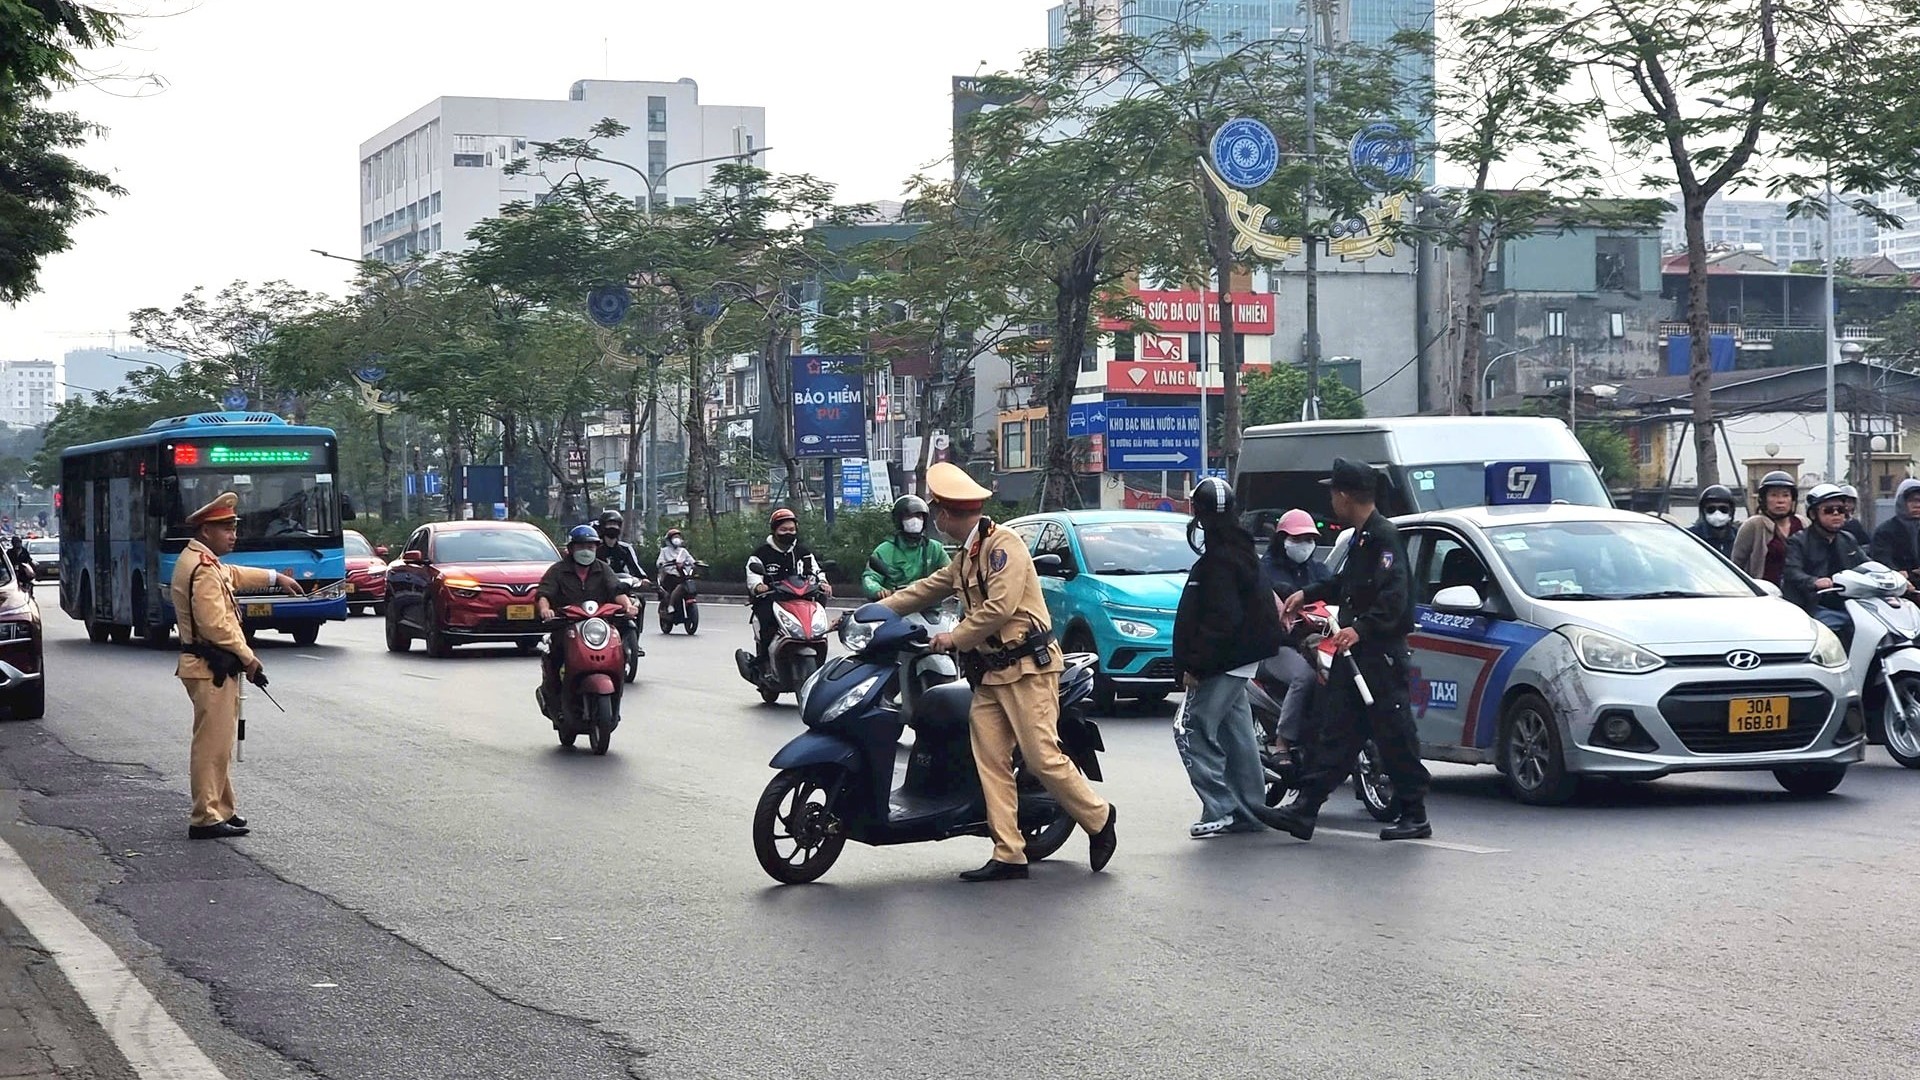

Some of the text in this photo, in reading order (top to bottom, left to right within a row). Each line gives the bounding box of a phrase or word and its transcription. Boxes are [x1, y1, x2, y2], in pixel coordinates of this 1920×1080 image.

[1149, 298, 1168, 320] SỨC
[1171, 298, 1184, 321] ĐÁ
[1238, 301, 1267, 323] NHIÊN
[1154, 367, 1185, 385] VÀNG
[795, 384, 861, 405] BẢO HIỂM
[818, 408, 840, 420] PVI
[1109, 414, 1200, 434] KHO BẠC NHÀ NƯỚC HÀ NỘI
[1507, 466, 1537, 499] G7
[1430, 681, 1457, 702] TAXI
[1747, 699, 1771, 714] 30A
[1737, 715, 1781, 731] 168.81
